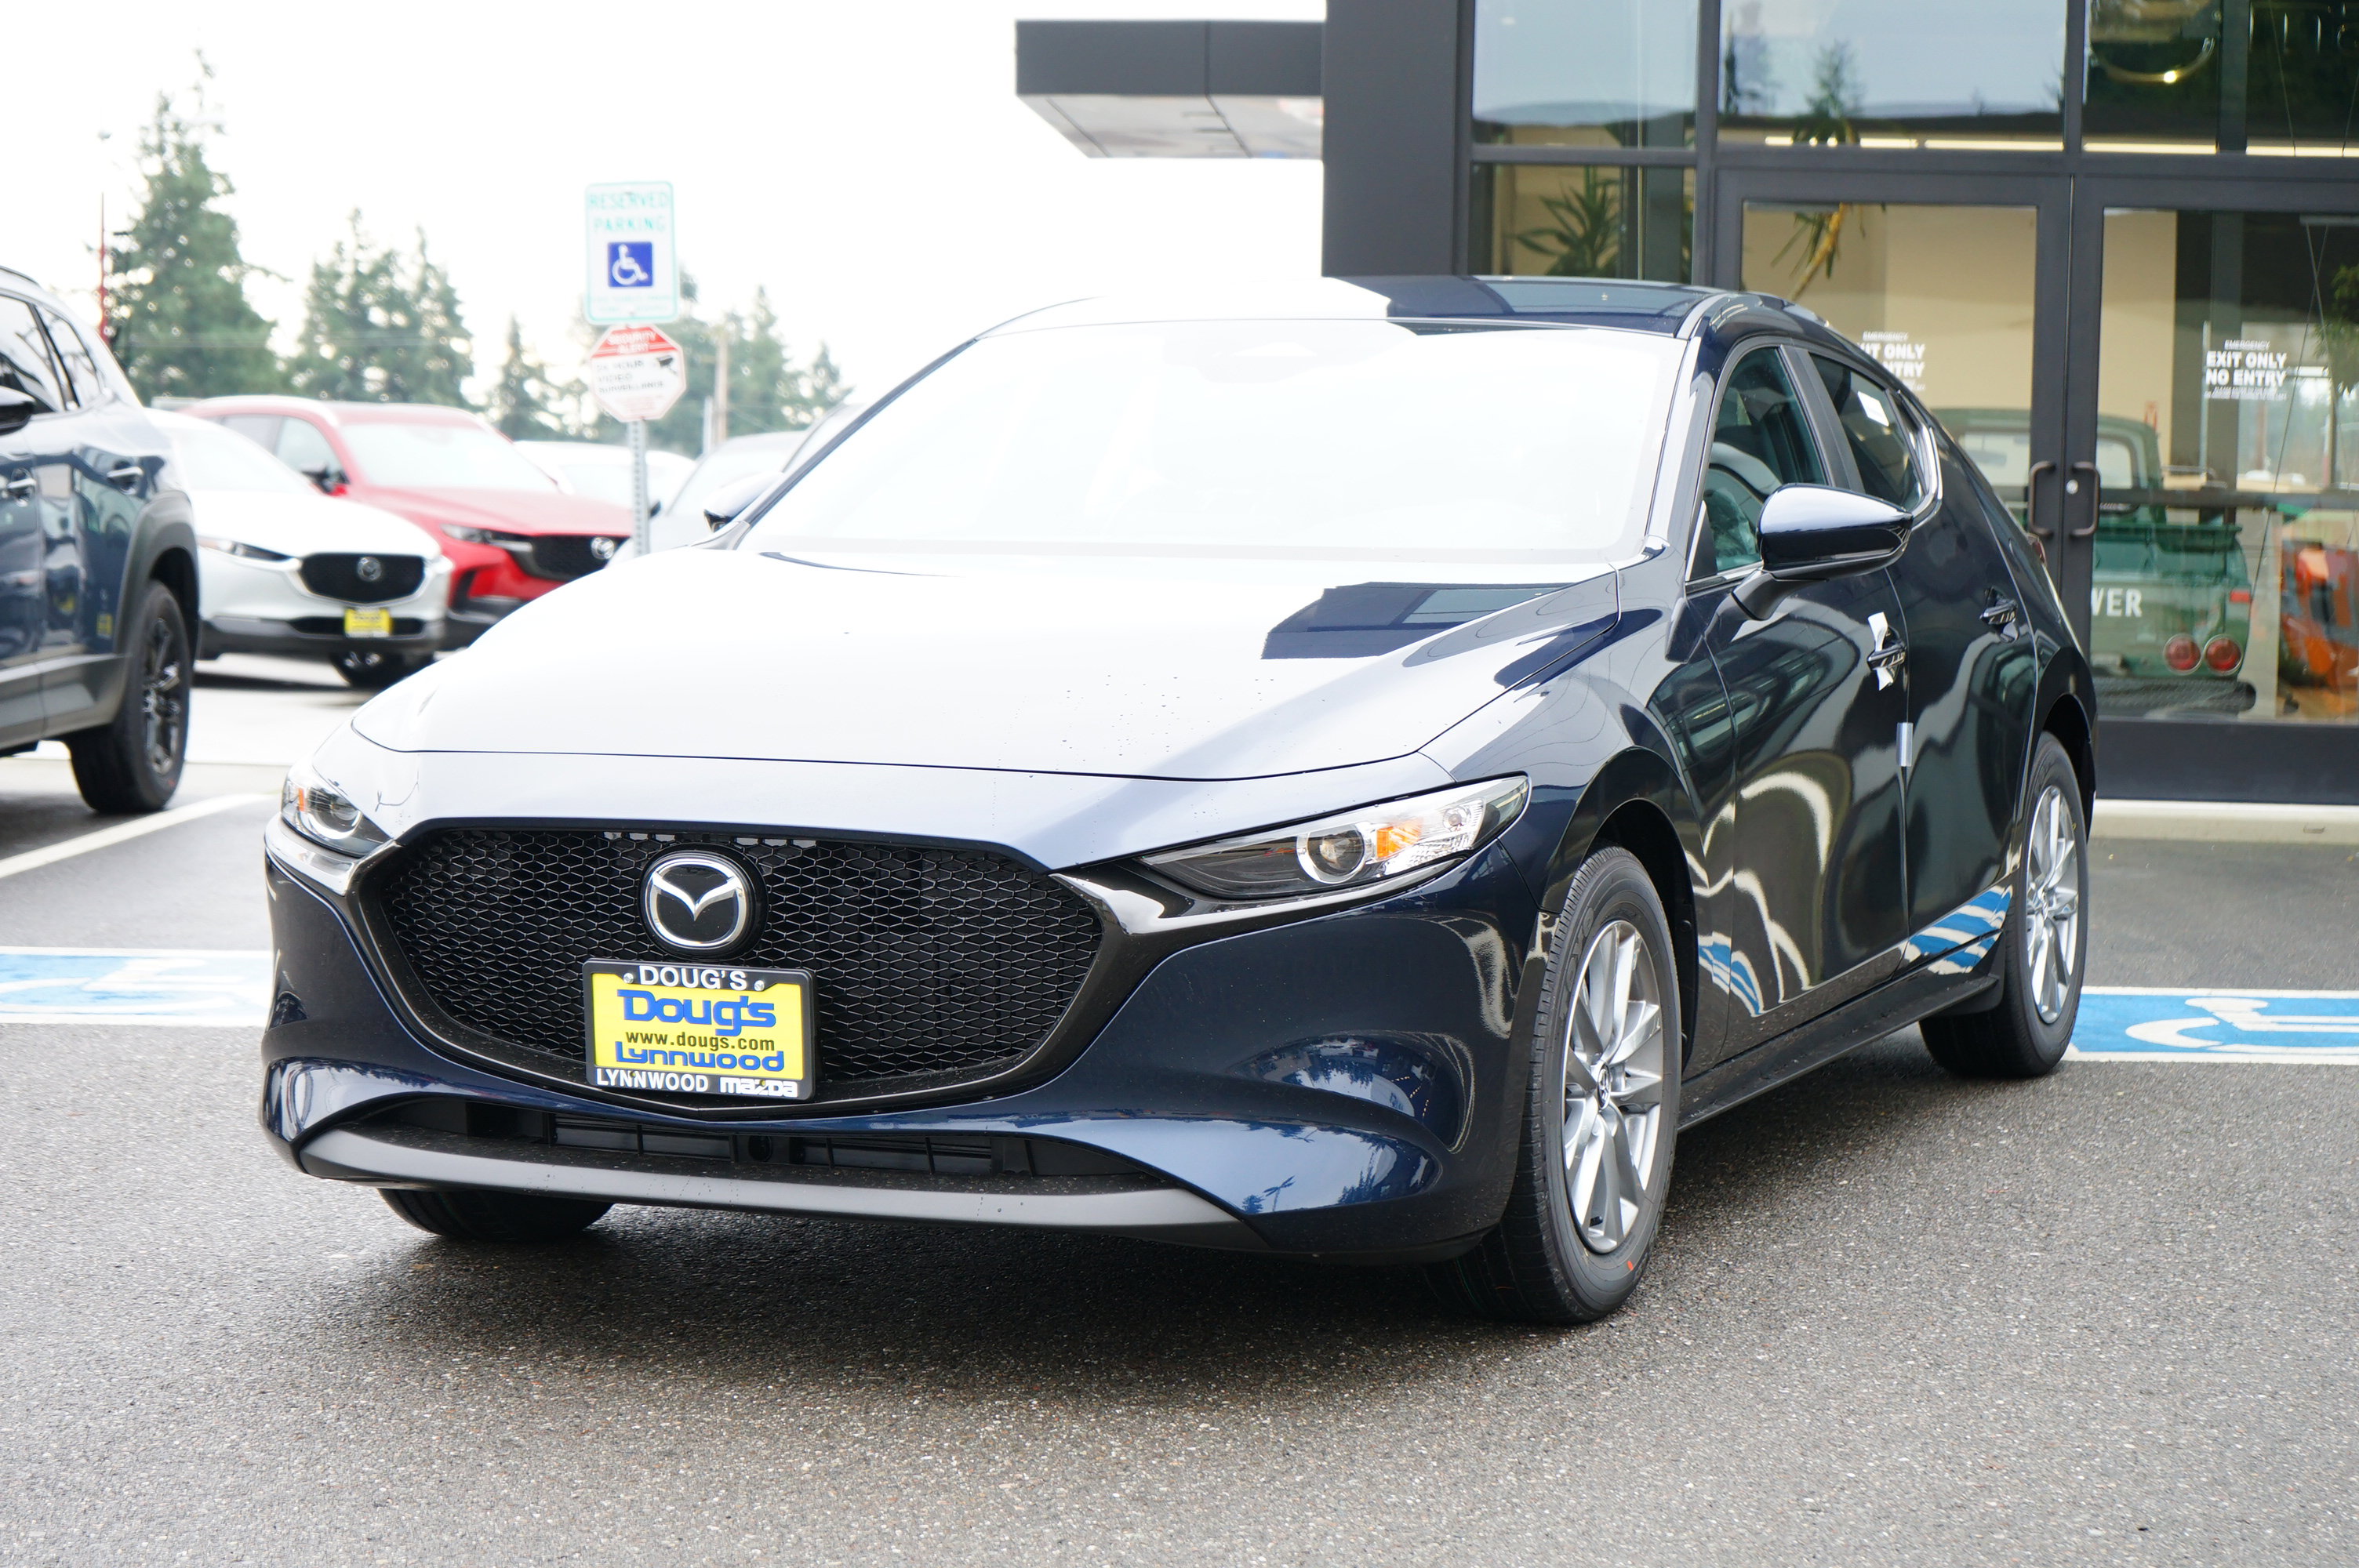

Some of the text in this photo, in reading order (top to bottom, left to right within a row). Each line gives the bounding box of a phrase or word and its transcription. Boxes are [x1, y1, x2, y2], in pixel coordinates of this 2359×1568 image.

[589, 191, 668, 209] RESERVED
[594, 216, 667, 233] PARKING
[1884, 343, 1925, 360] ONLY
[2224, 339, 2271, 350] EMERGENCY
[2206, 350, 2288, 369] EXIT ONLY
[2205, 368, 2288, 387] NO ENTRY
[639, 965, 747, 991] DOUG'S
[616, 989, 776, 1036] Doug's
[625, 1031, 775, 1051] www.dougs.com
[615, 1040, 785, 1072] Lynnwood
[596, 1068, 709, 1093] LYNNWOOD
